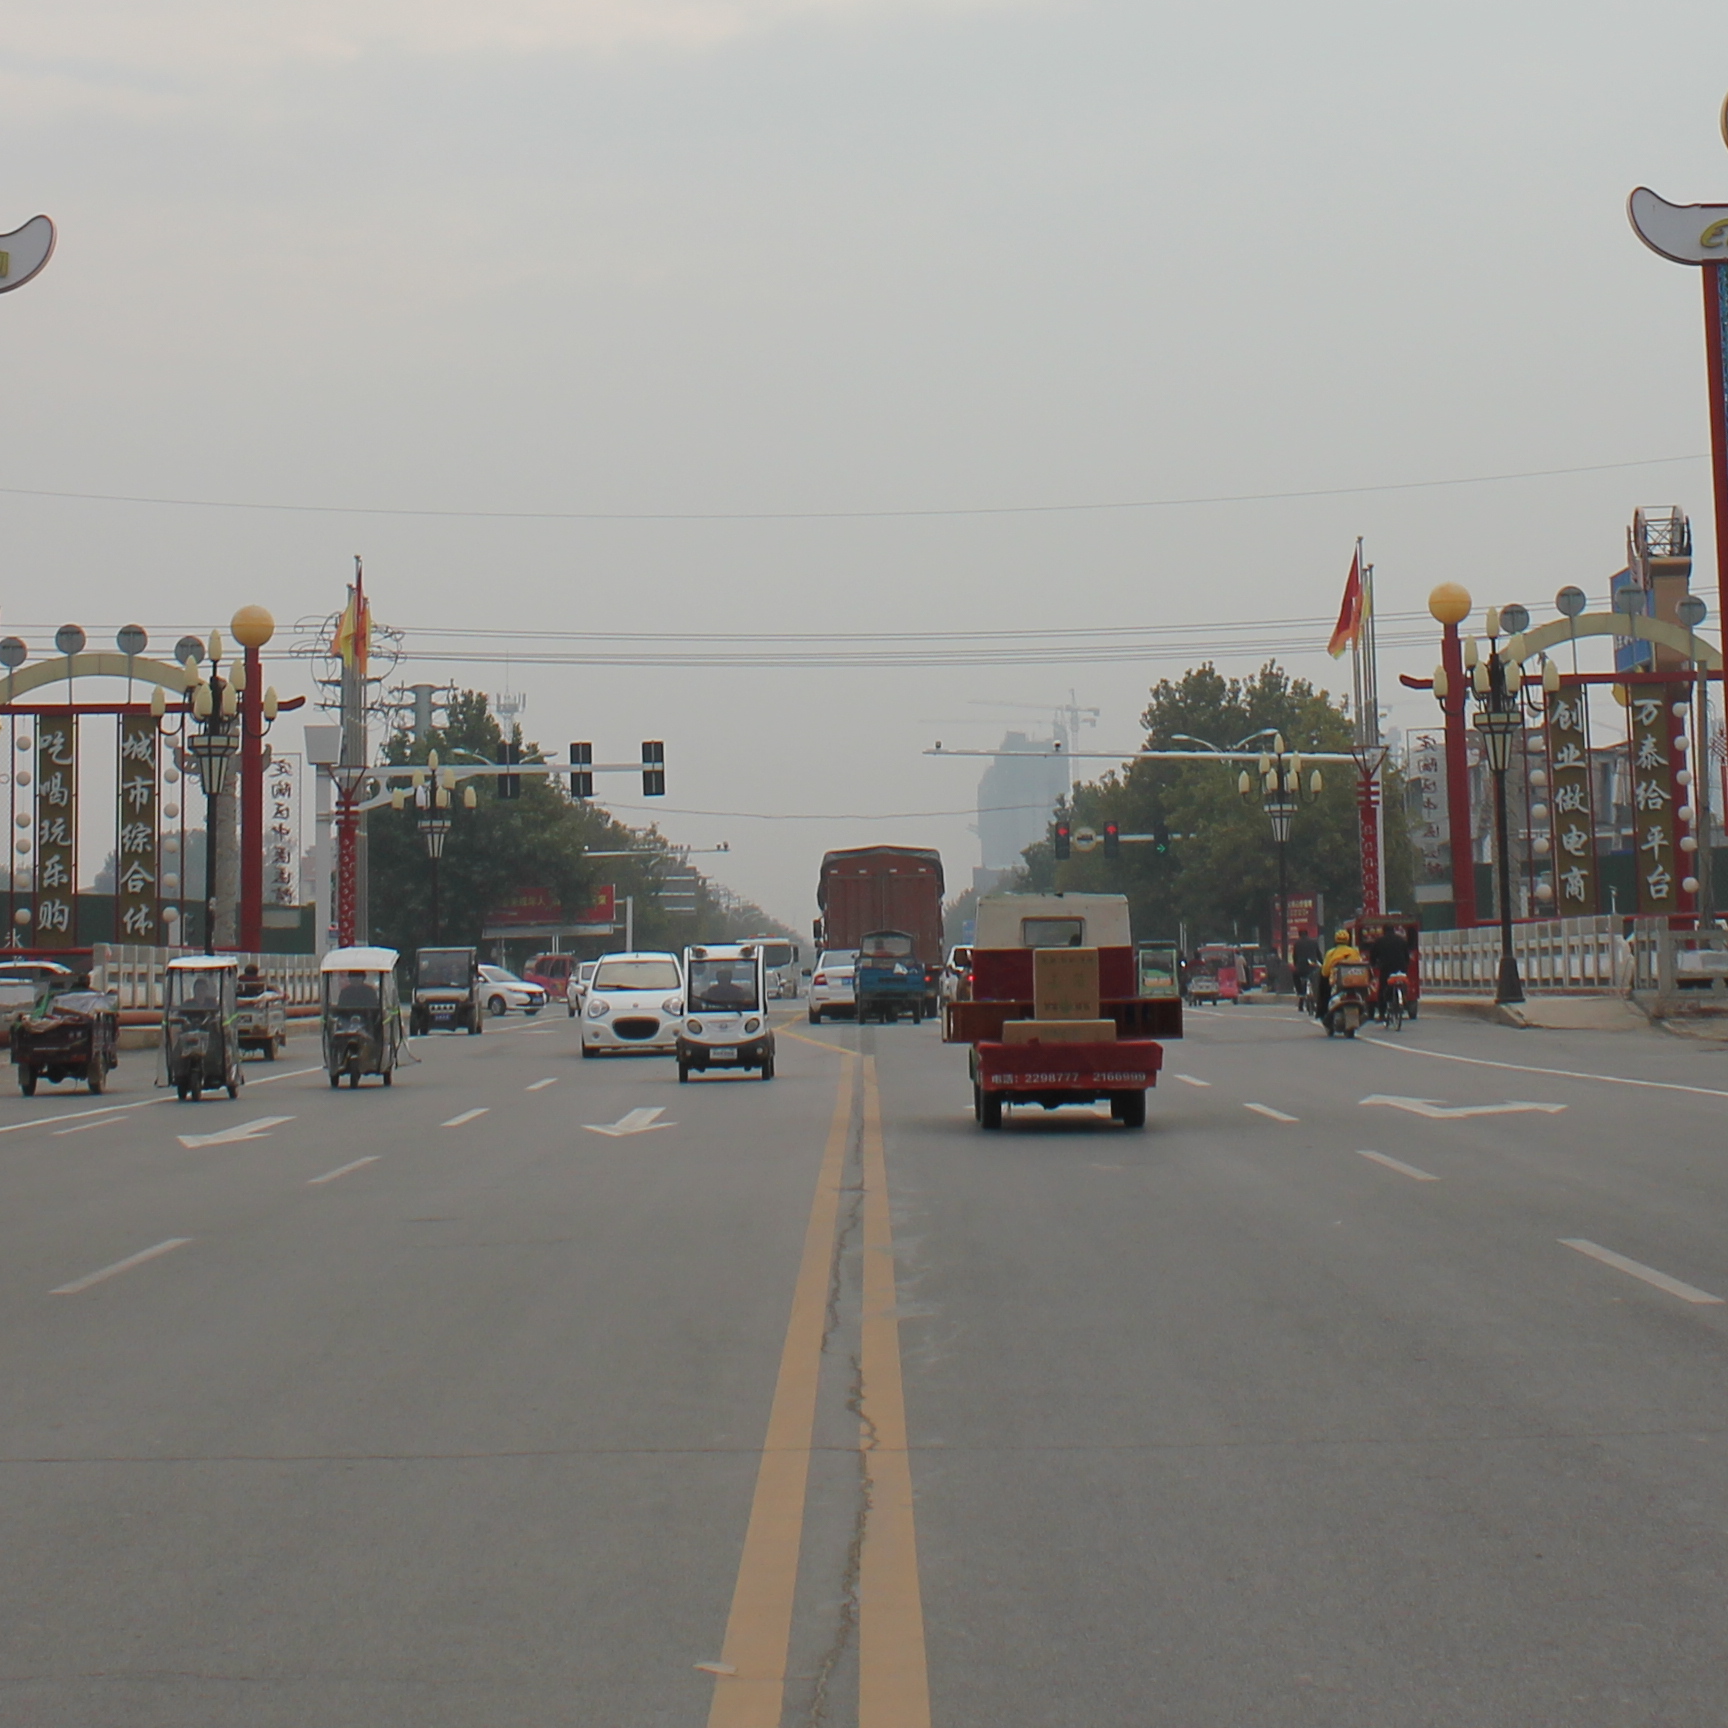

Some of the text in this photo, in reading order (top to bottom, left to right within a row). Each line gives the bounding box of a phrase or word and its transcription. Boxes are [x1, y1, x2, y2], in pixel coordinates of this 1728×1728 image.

[38, 731, 73, 933] 吃喝玩乐购
[120, 730, 156, 936] 城市综合体
[1551, 698, 1589, 903] 创业做电商
